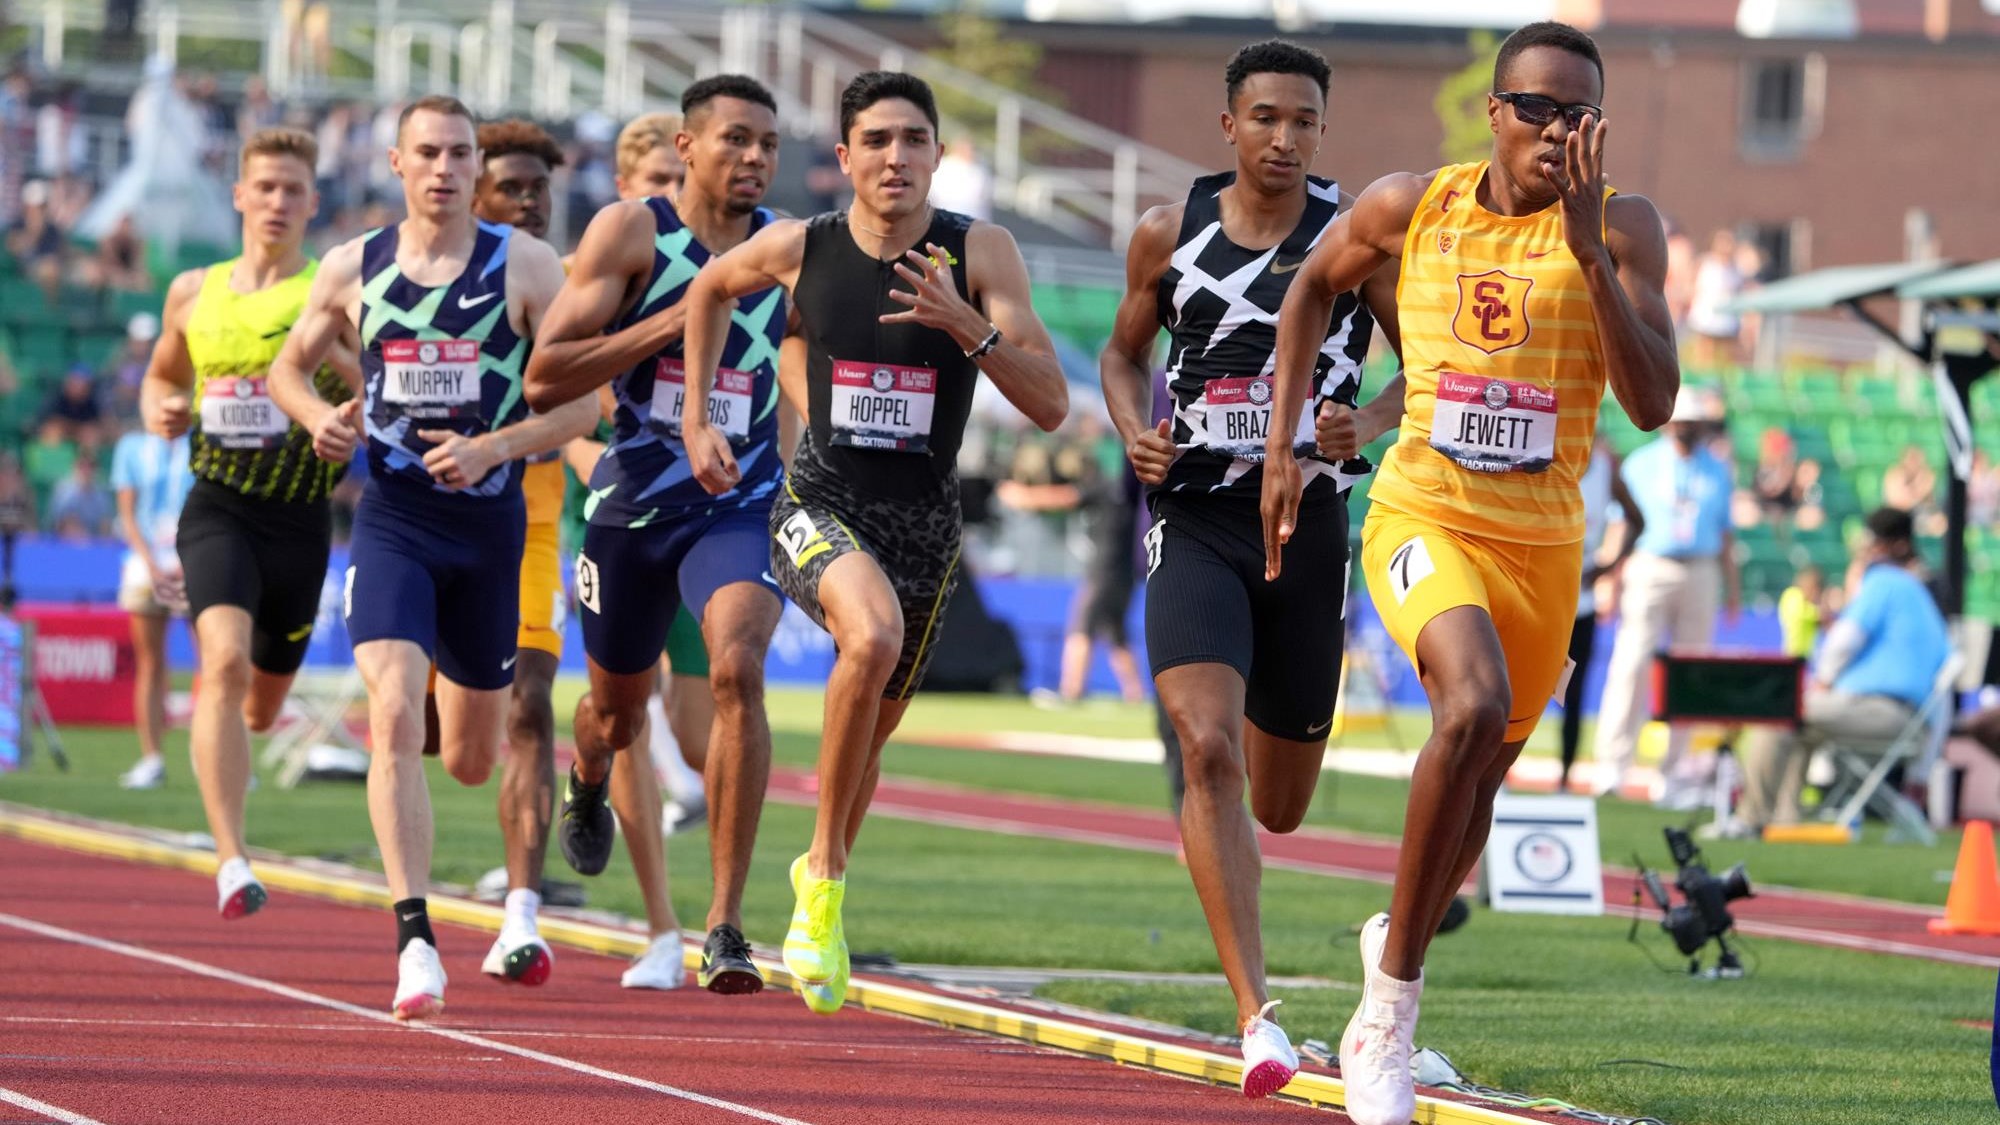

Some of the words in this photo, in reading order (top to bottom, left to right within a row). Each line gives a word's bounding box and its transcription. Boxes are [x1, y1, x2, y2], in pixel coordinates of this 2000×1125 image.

[1472, 280, 1512, 342] SC
[398, 370, 464, 396] MURPHY
[672, 391, 732, 426] HRIS
[849, 394, 912, 427] HOPPEL
[1225, 409, 1272, 440] BRAZ
[1453, 411, 1534, 450] JEWETT
[1232, 452, 1267, 464] TRACKT
[1454, 457, 1513, 473] TRACKTOWN
[784, 515, 807, 554] 5
[579, 560, 593, 604] 9
[1389, 543, 1415, 592] 7
